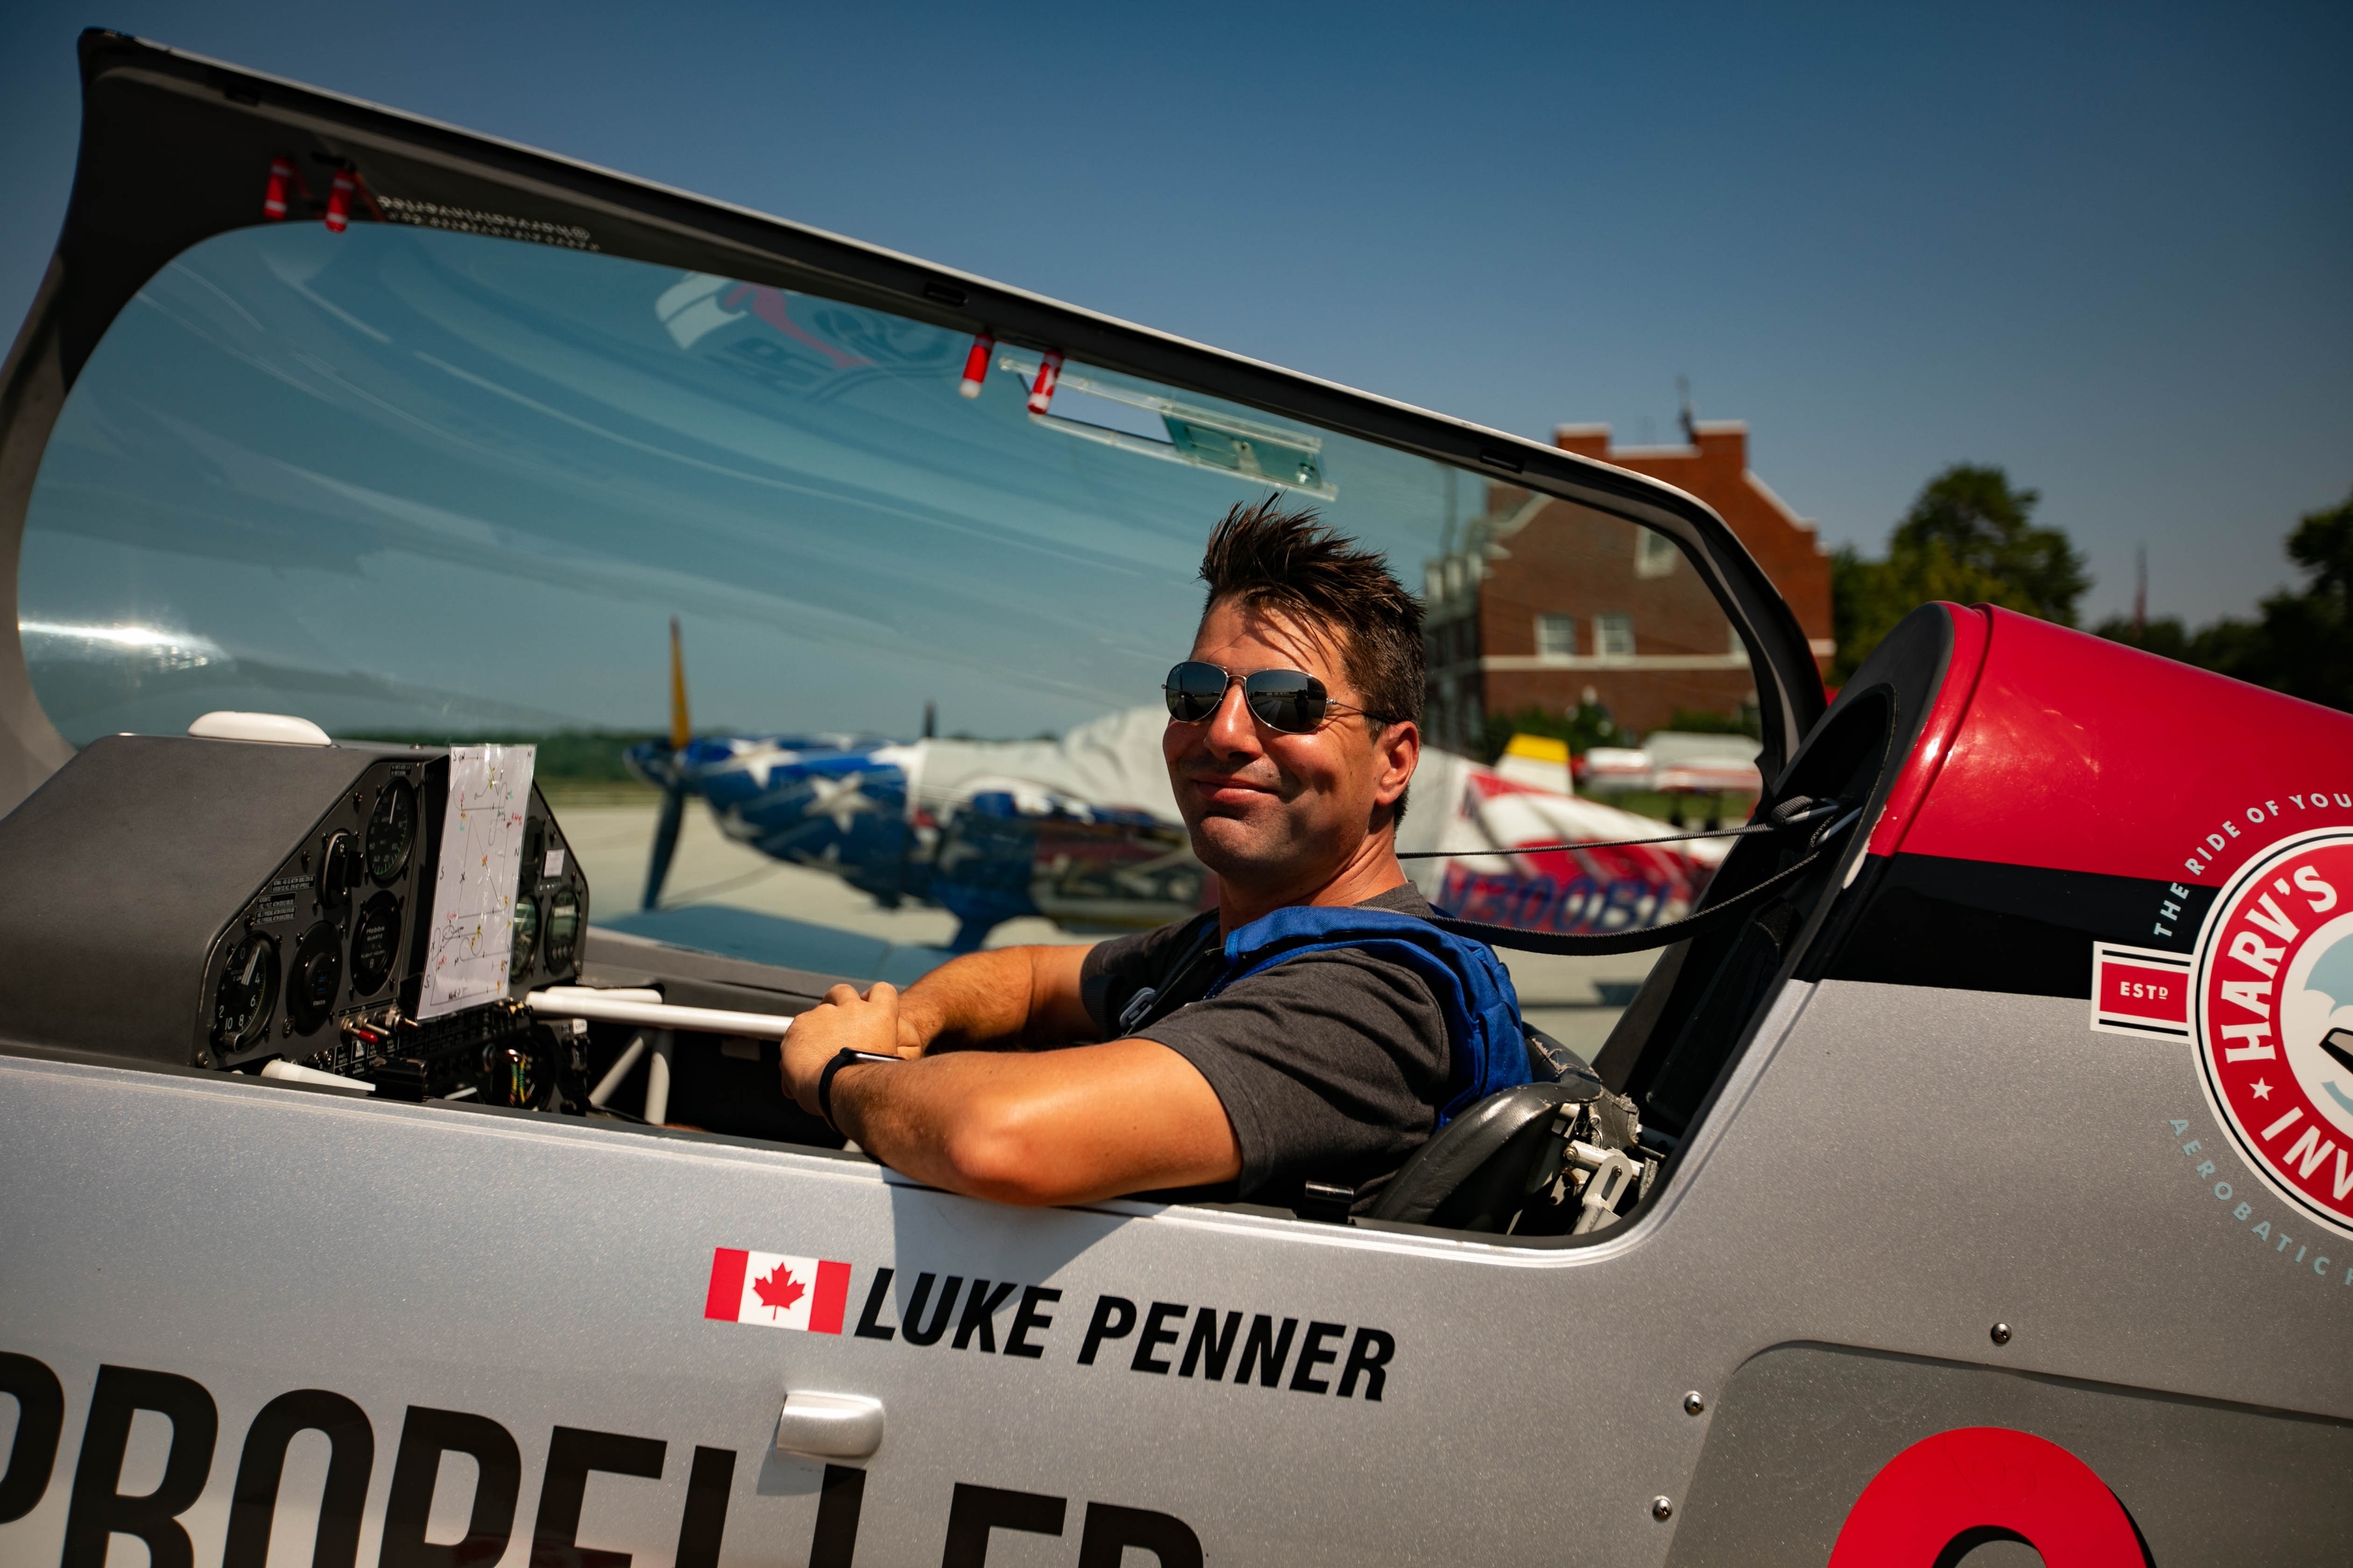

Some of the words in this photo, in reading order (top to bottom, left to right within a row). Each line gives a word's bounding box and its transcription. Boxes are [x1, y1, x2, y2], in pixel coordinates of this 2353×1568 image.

[2153, 882, 2190, 938] THE
[2184, 820, 2241, 876] RIDE
[2246, 800, 2279, 824] OF
[2288, 792, 2352, 810] YOU
[240, 947, 246, 960] 0
[255, 973, 260, 985] 4
[2220, 866, 2338, 1063] HARV'S
[219, 1005, 224, 1018] 2
[225, 1017, 233, 1030] 10
[239, 1015, 244, 1027] 8
[250, 995, 256, 1007] 6
[2261, 1106, 2353, 1201] INV
[2168, 1119, 2330, 1275] AEROBATIC
[854, 1267, 1063, 1360] LUKE
[1076, 1294, 1396, 1401] PENNER
[0, 1351, 1204, 1568] PROPE
